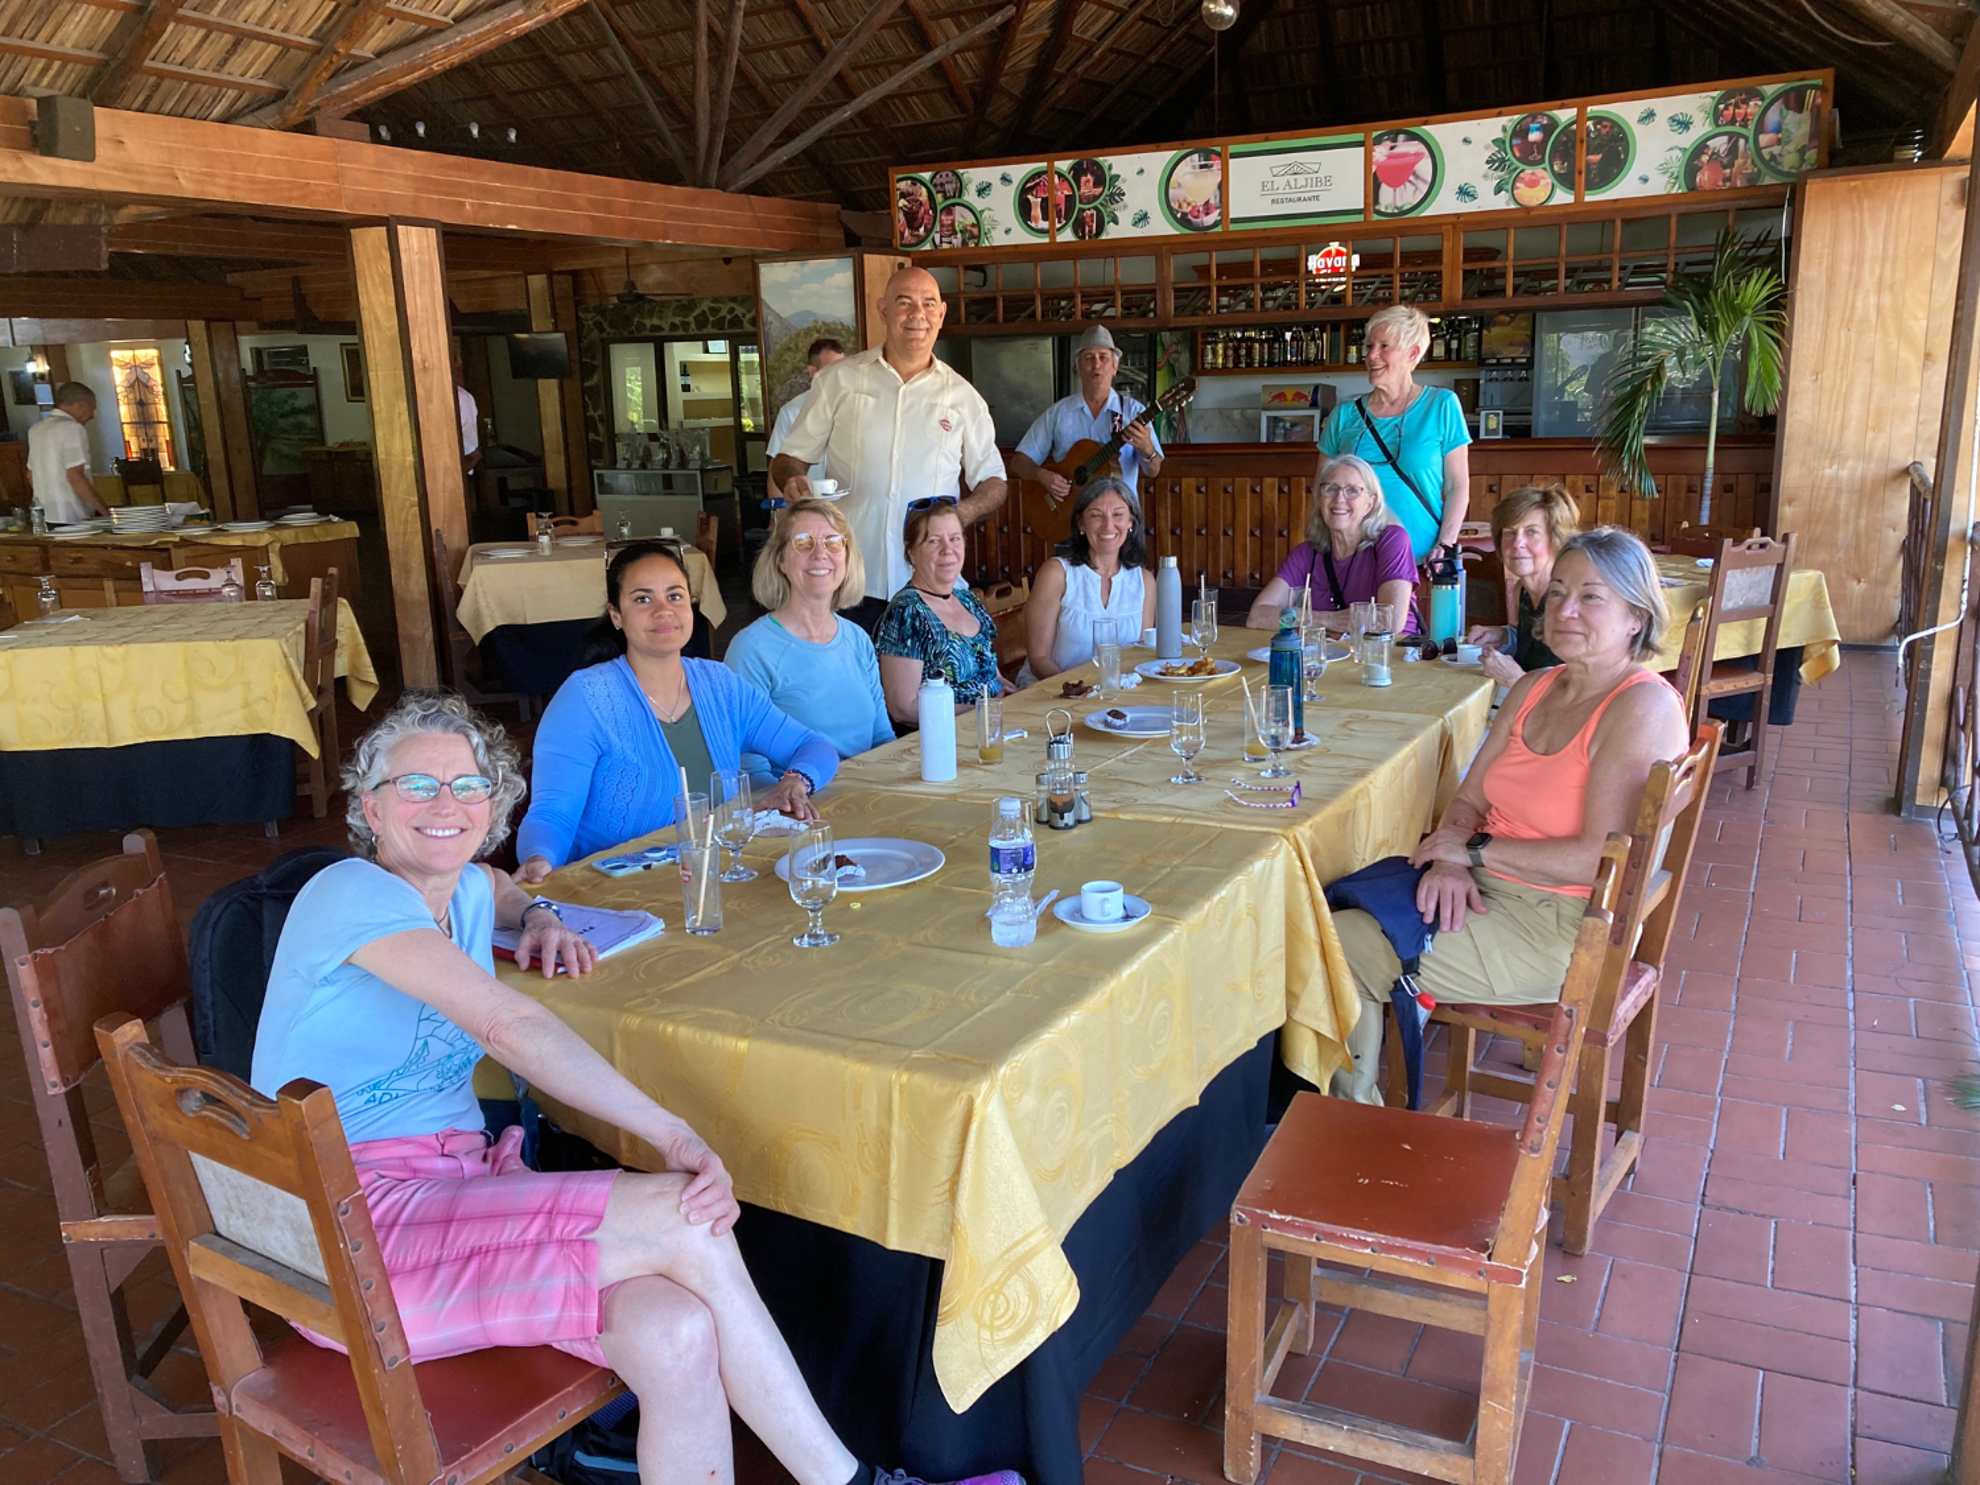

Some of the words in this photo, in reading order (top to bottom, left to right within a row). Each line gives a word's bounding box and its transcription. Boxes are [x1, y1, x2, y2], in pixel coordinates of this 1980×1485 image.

[1261, 180, 1279, 192] EL
[1282, 175, 1333, 191] ALJIBE
[1271, 195, 1320, 205] RESTAURANTE
